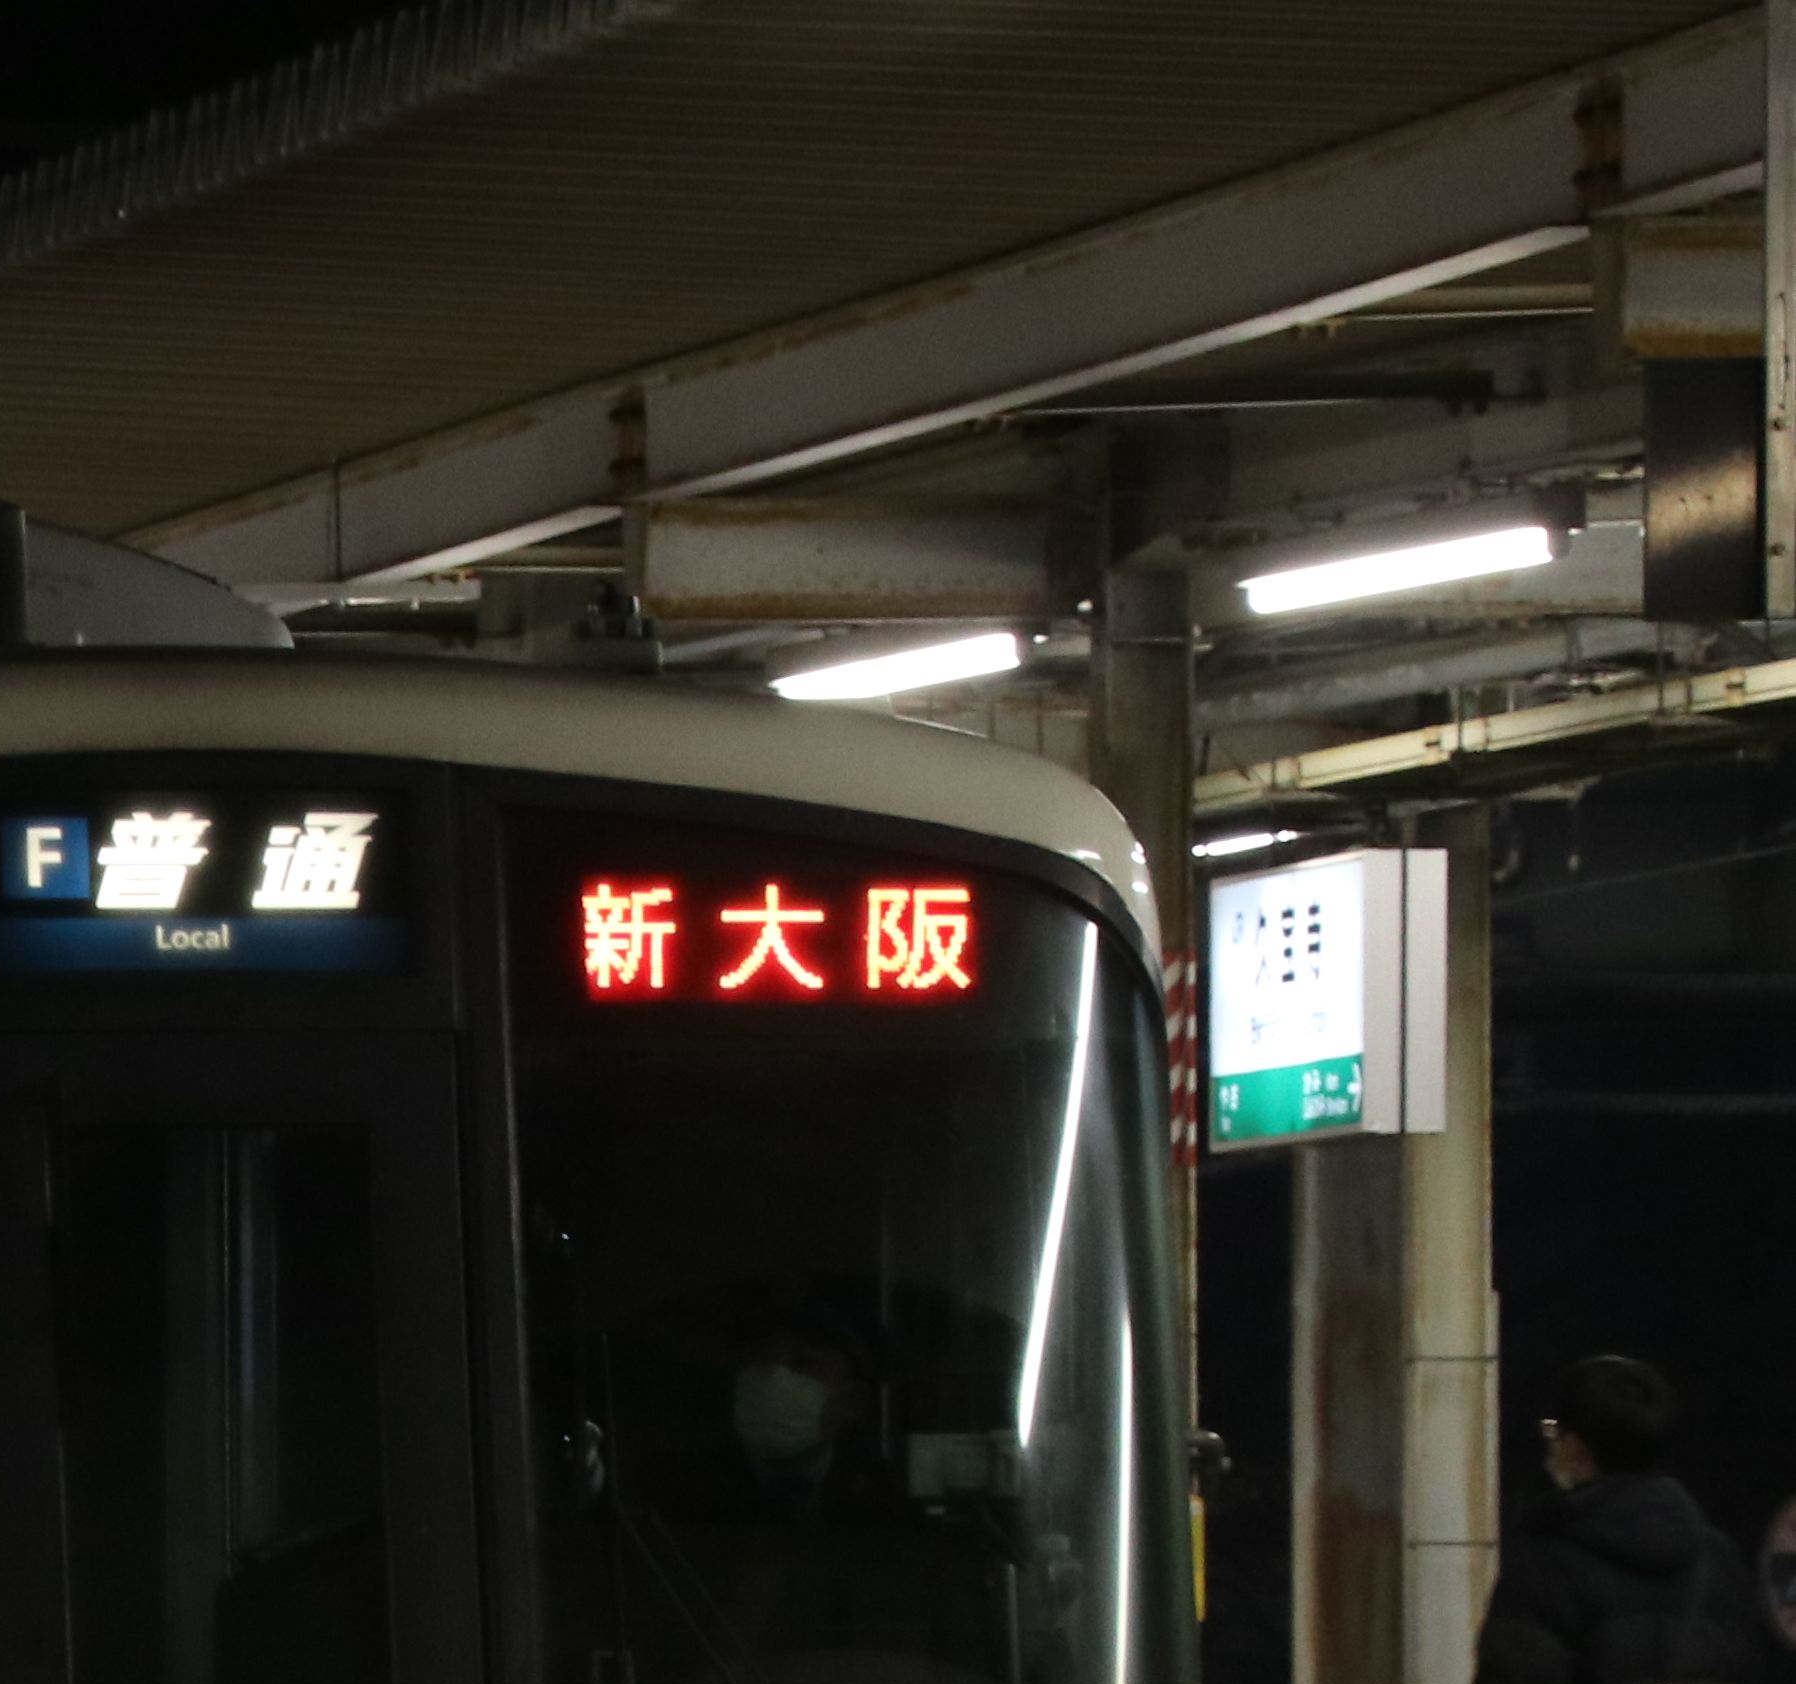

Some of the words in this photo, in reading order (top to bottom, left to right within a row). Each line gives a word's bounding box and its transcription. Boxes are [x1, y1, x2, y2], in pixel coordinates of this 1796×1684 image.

[24, 825, 64, 889] F
[95, 811, 381, 910] 普通
[155, 922, 231, 951] Local
[582, 883, 972, 989] 新大阪
